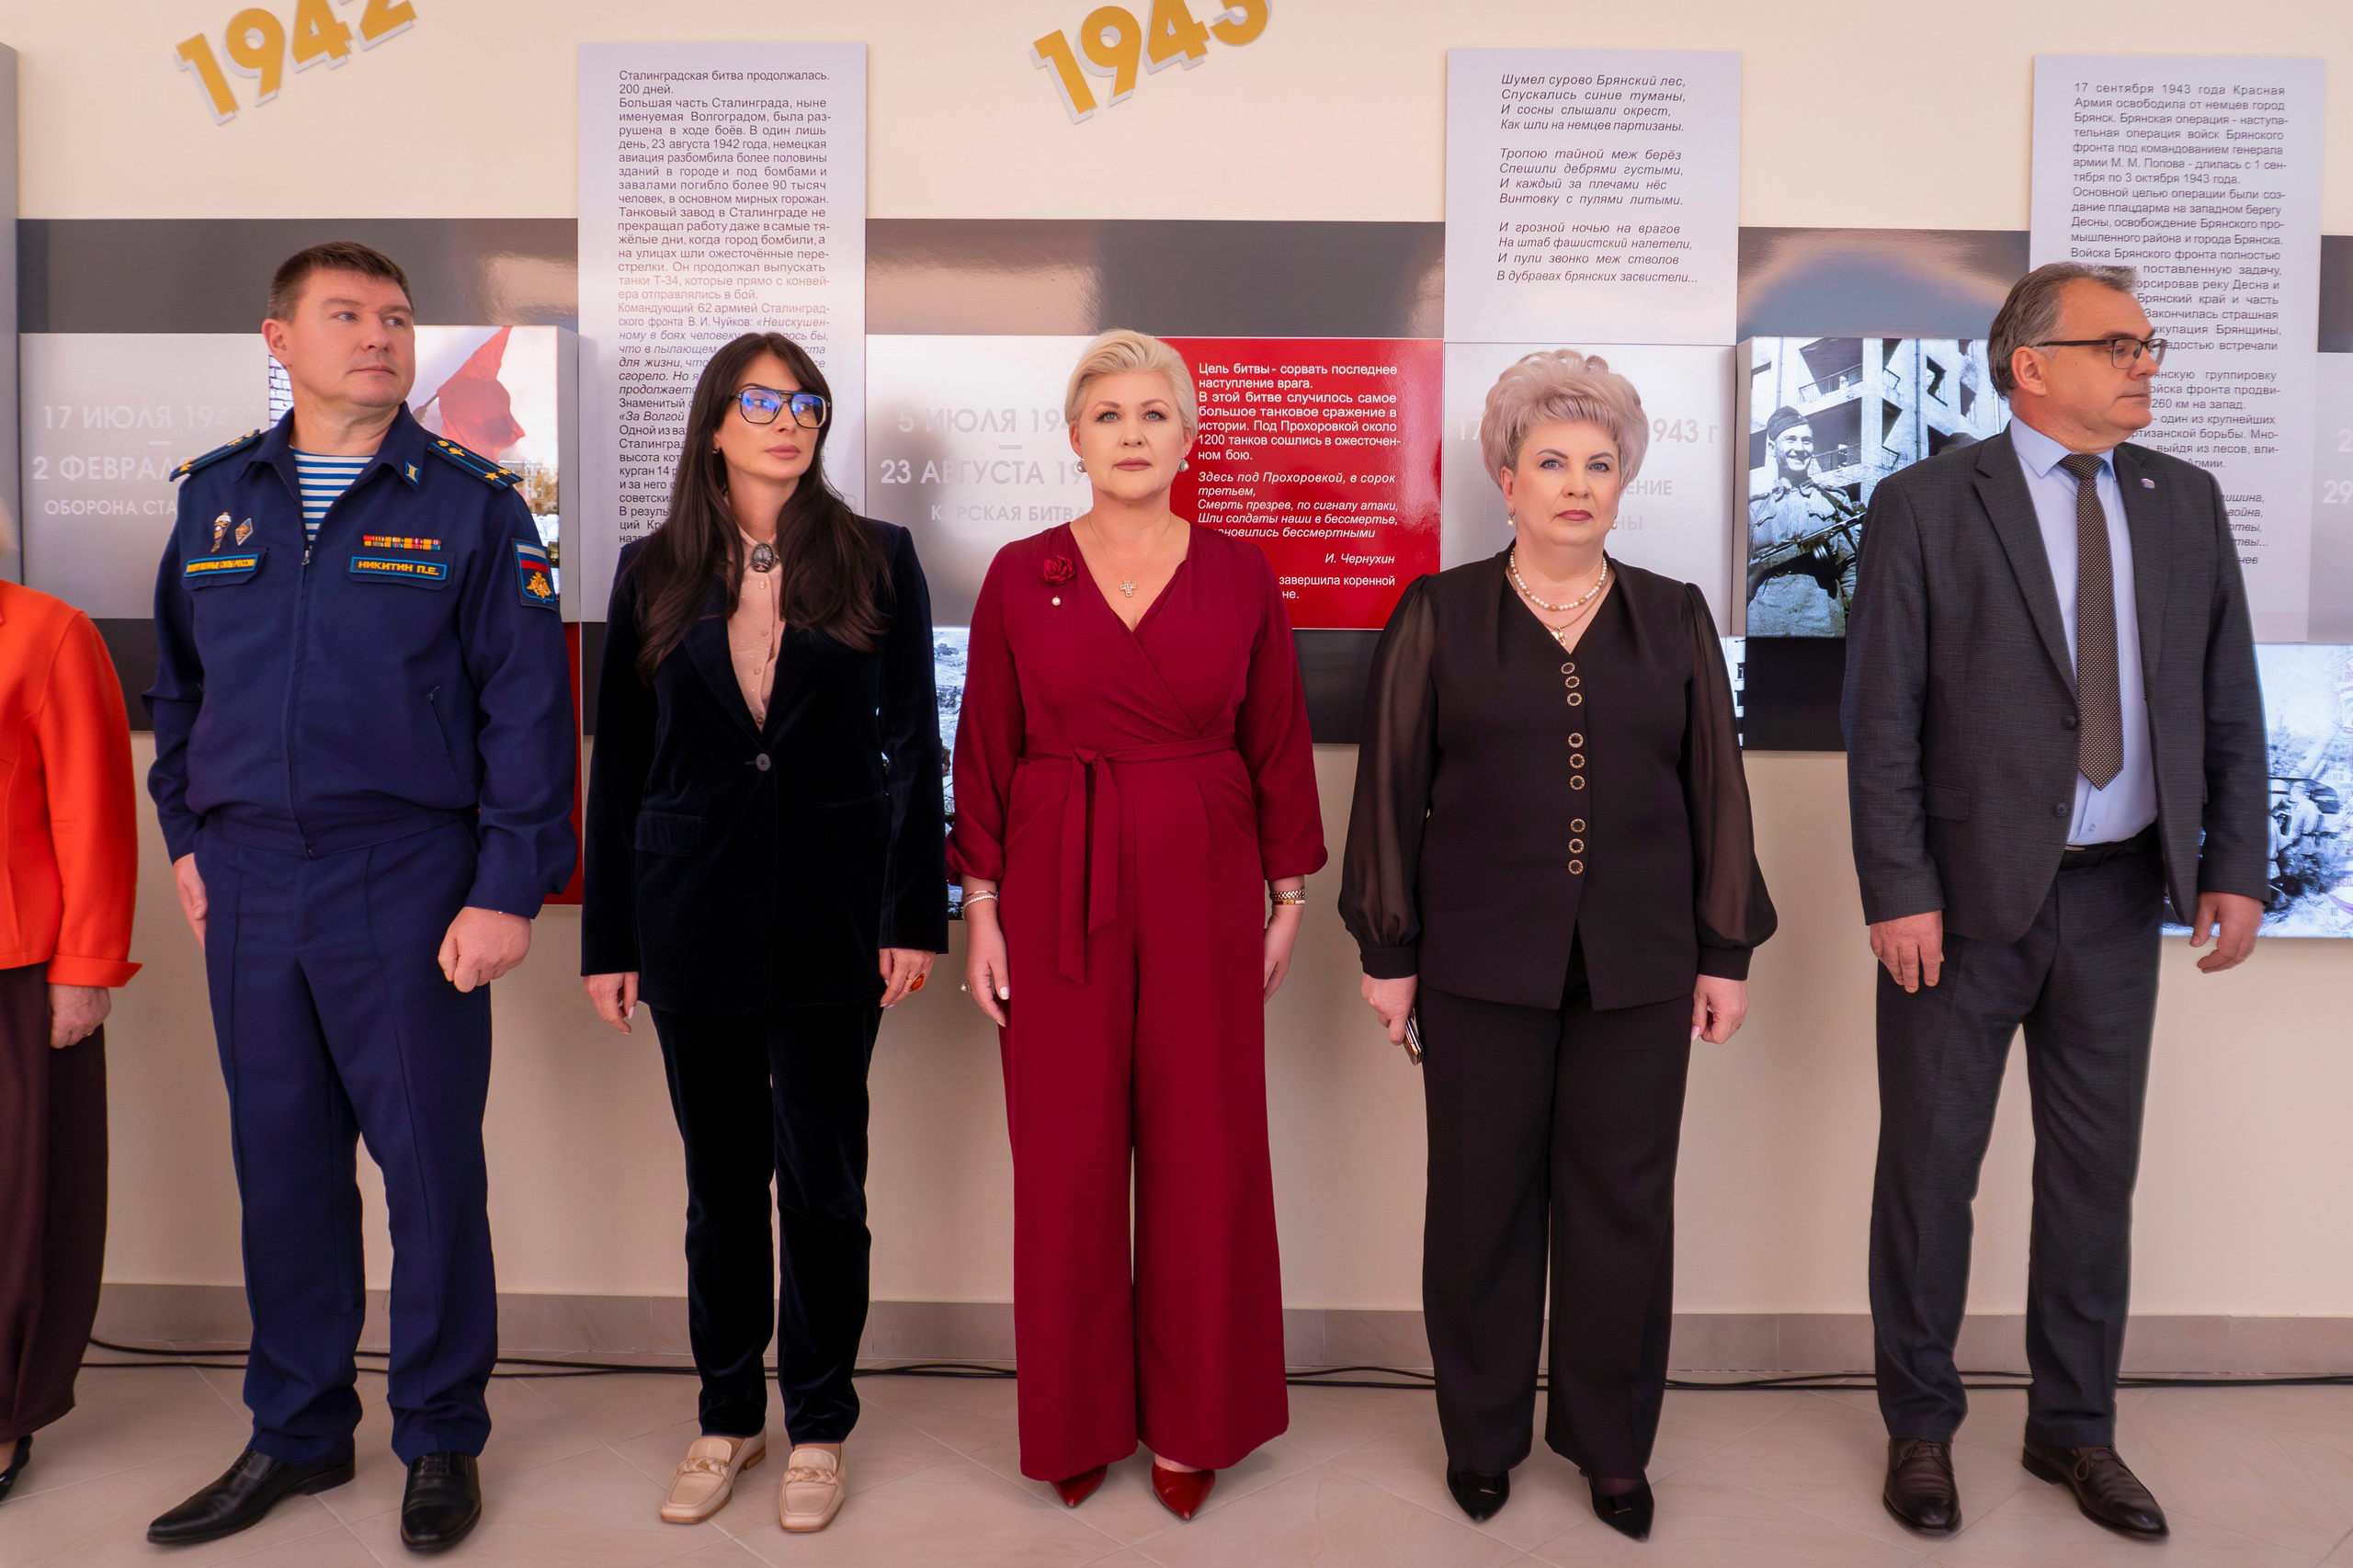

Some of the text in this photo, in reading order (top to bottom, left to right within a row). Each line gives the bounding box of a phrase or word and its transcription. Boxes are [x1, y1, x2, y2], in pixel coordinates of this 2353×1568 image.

[620, 70, 829, 82] Сталинградская битва продолжалась.
[1501, 74, 1686, 88] Шумел сурово Брянский лес,
[619, 84, 674, 96] 200 дней.
[1502, 88, 1686, 103] Спускались синие туманы,
[2075, 83, 2285, 97] 17 сентября 1943 года Красная
[620, 97, 826, 109] Большая часть Сталинграда, ныне
[2075, 97, 2285, 112] Армия освободила от немцев город
[620, 111, 831, 123] именуемая Волгоградом, была раз-
[1501, 104, 1670, 119] И сосны слышали окрест,
[2075, 111, 2289, 127] Брянск. Брянская операция наступа-
[619, 124, 826, 137] рушена в ходе боёв. В один лишь
[1500, 119, 1684, 133] Как шли на немцев партизаны.
[2074, 129, 2284, 142] тельная операция войск Брянского
[619, 138, 826, 151] день, 23 августа 1942 года, немецкая
[619, 152, 827, 165] авиация разбомбила более половины
[1500, 148, 1681, 162] Тропою тайной меж берёз
[1499, 163, 1683, 176] Спешили дебрями густыми,
[1499, 177, 1667, 190] И каждый за плечами нёс
[1499, 193, 1683, 207] Винтовку с пулями литыми.
[1199, 362, 1397, 376] Цель битвы сорвать последнее
[1199, 380, 1313, 391] наступление врага.
[1199, 391, 1397, 404] В этой битве случилось самое
[42, 405, 73, 429] 17
[83, 405, 172, 429] ИЮЛЯ
[1199, 407, 1397, 419] большое танковое сражение в
[898, 408, 915, 433] 5
[925, 408, 1017, 433] ИЮЛЯ
[1199, 420, 1397, 434] истории. Под Прохоровкой около
[1653, 418, 1699, 444] 943
[1198, 434, 1401, 446] 1200 танков сошлись в ожесточен-
[1198, 449, 1253, 460] ном бою.
[33, 456, 50, 480] 2
[880, 459, 1091, 484] 23 АВГУСТА 19
[1198, 472, 1396, 485] Здесь под Прохоровкой, в сорок
[1198, 487, 1256, 498] третьем,
[44, 499, 139, 516] ОБОРОНА
[1198, 498, 1398, 513] Смерть презрев, по сигналу атаки,
[1198, 512, 1398, 526] Шли солдаты наши в бессмертье,
[1283, 527, 1375, 540] бессмертными
[1324, 553, 1395, 566] И. Чернухин
[358, 561, 439, 576] НИКИТИН П.Е.
[1279, 575, 1395, 587] завершила коренной
